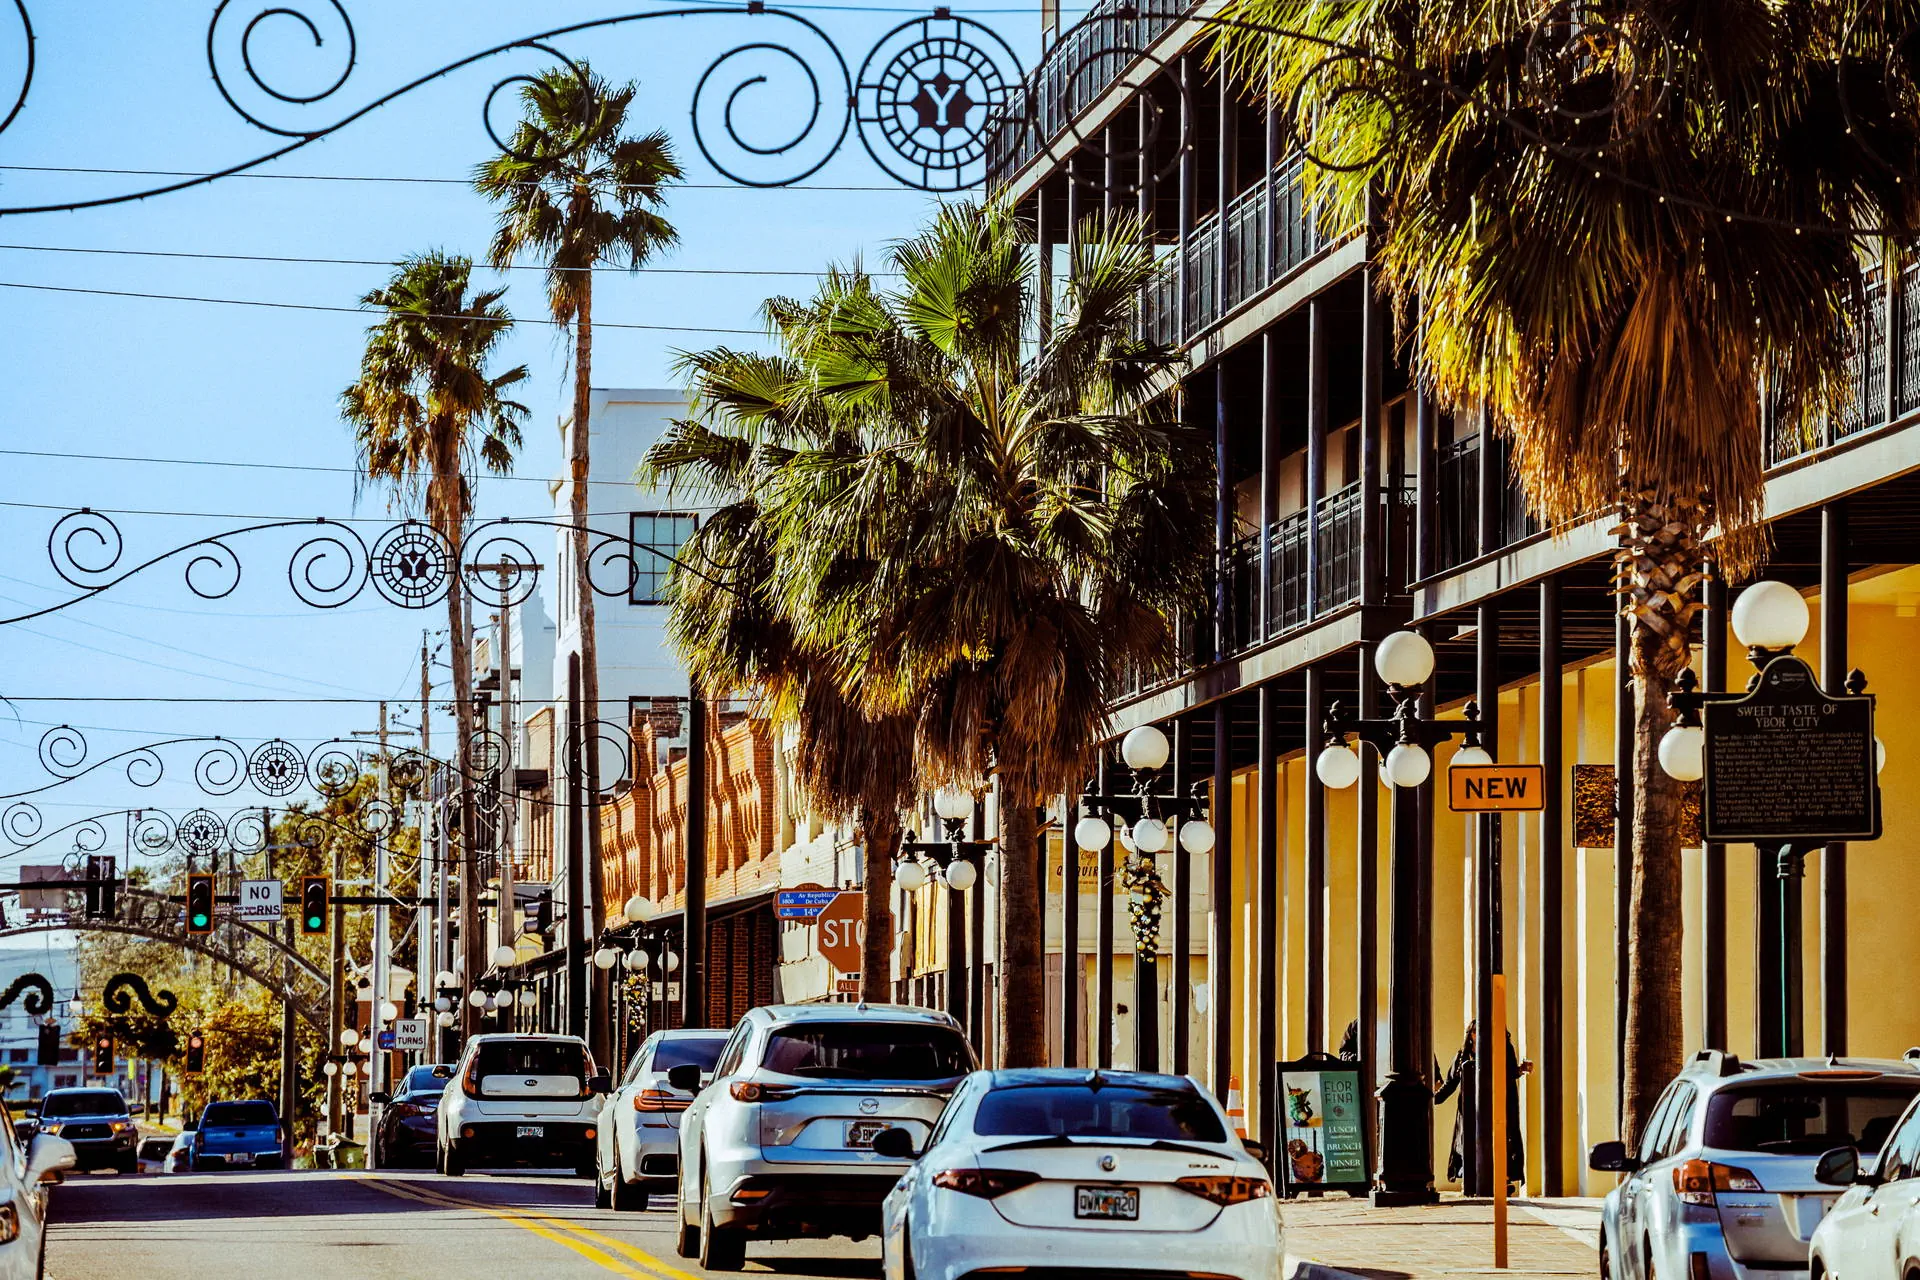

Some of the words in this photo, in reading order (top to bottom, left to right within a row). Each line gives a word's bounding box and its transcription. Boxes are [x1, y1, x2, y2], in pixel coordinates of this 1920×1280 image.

[1737, 705, 1775, 717] SWEET
[1782, 704, 1817, 716] TASTE
[1822, 703, 1838, 715] OF
[1755, 717, 1786, 728] YBOR
[1793, 717, 1821, 727] CITY
[1465, 777, 1527, 799] NEW
[250, 886, 270, 899] NO
[244, 905, 280, 915] RNS
[823, 919, 864, 948] STO
[840, 982, 853, 990] ALL
[402, 1024, 416, 1033] NO
[397, 1037, 423, 1045] TURNS
[1324, 1081, 1352, 1093] FLOR
[1325, 1092, 1353, 1104] FINA
[1328, 1125, 1357, 1134] LUNCH
[1327, 1142, 1362, 1151] BRUNCH
[1330, 1159, 1361, 1167] DINNER
